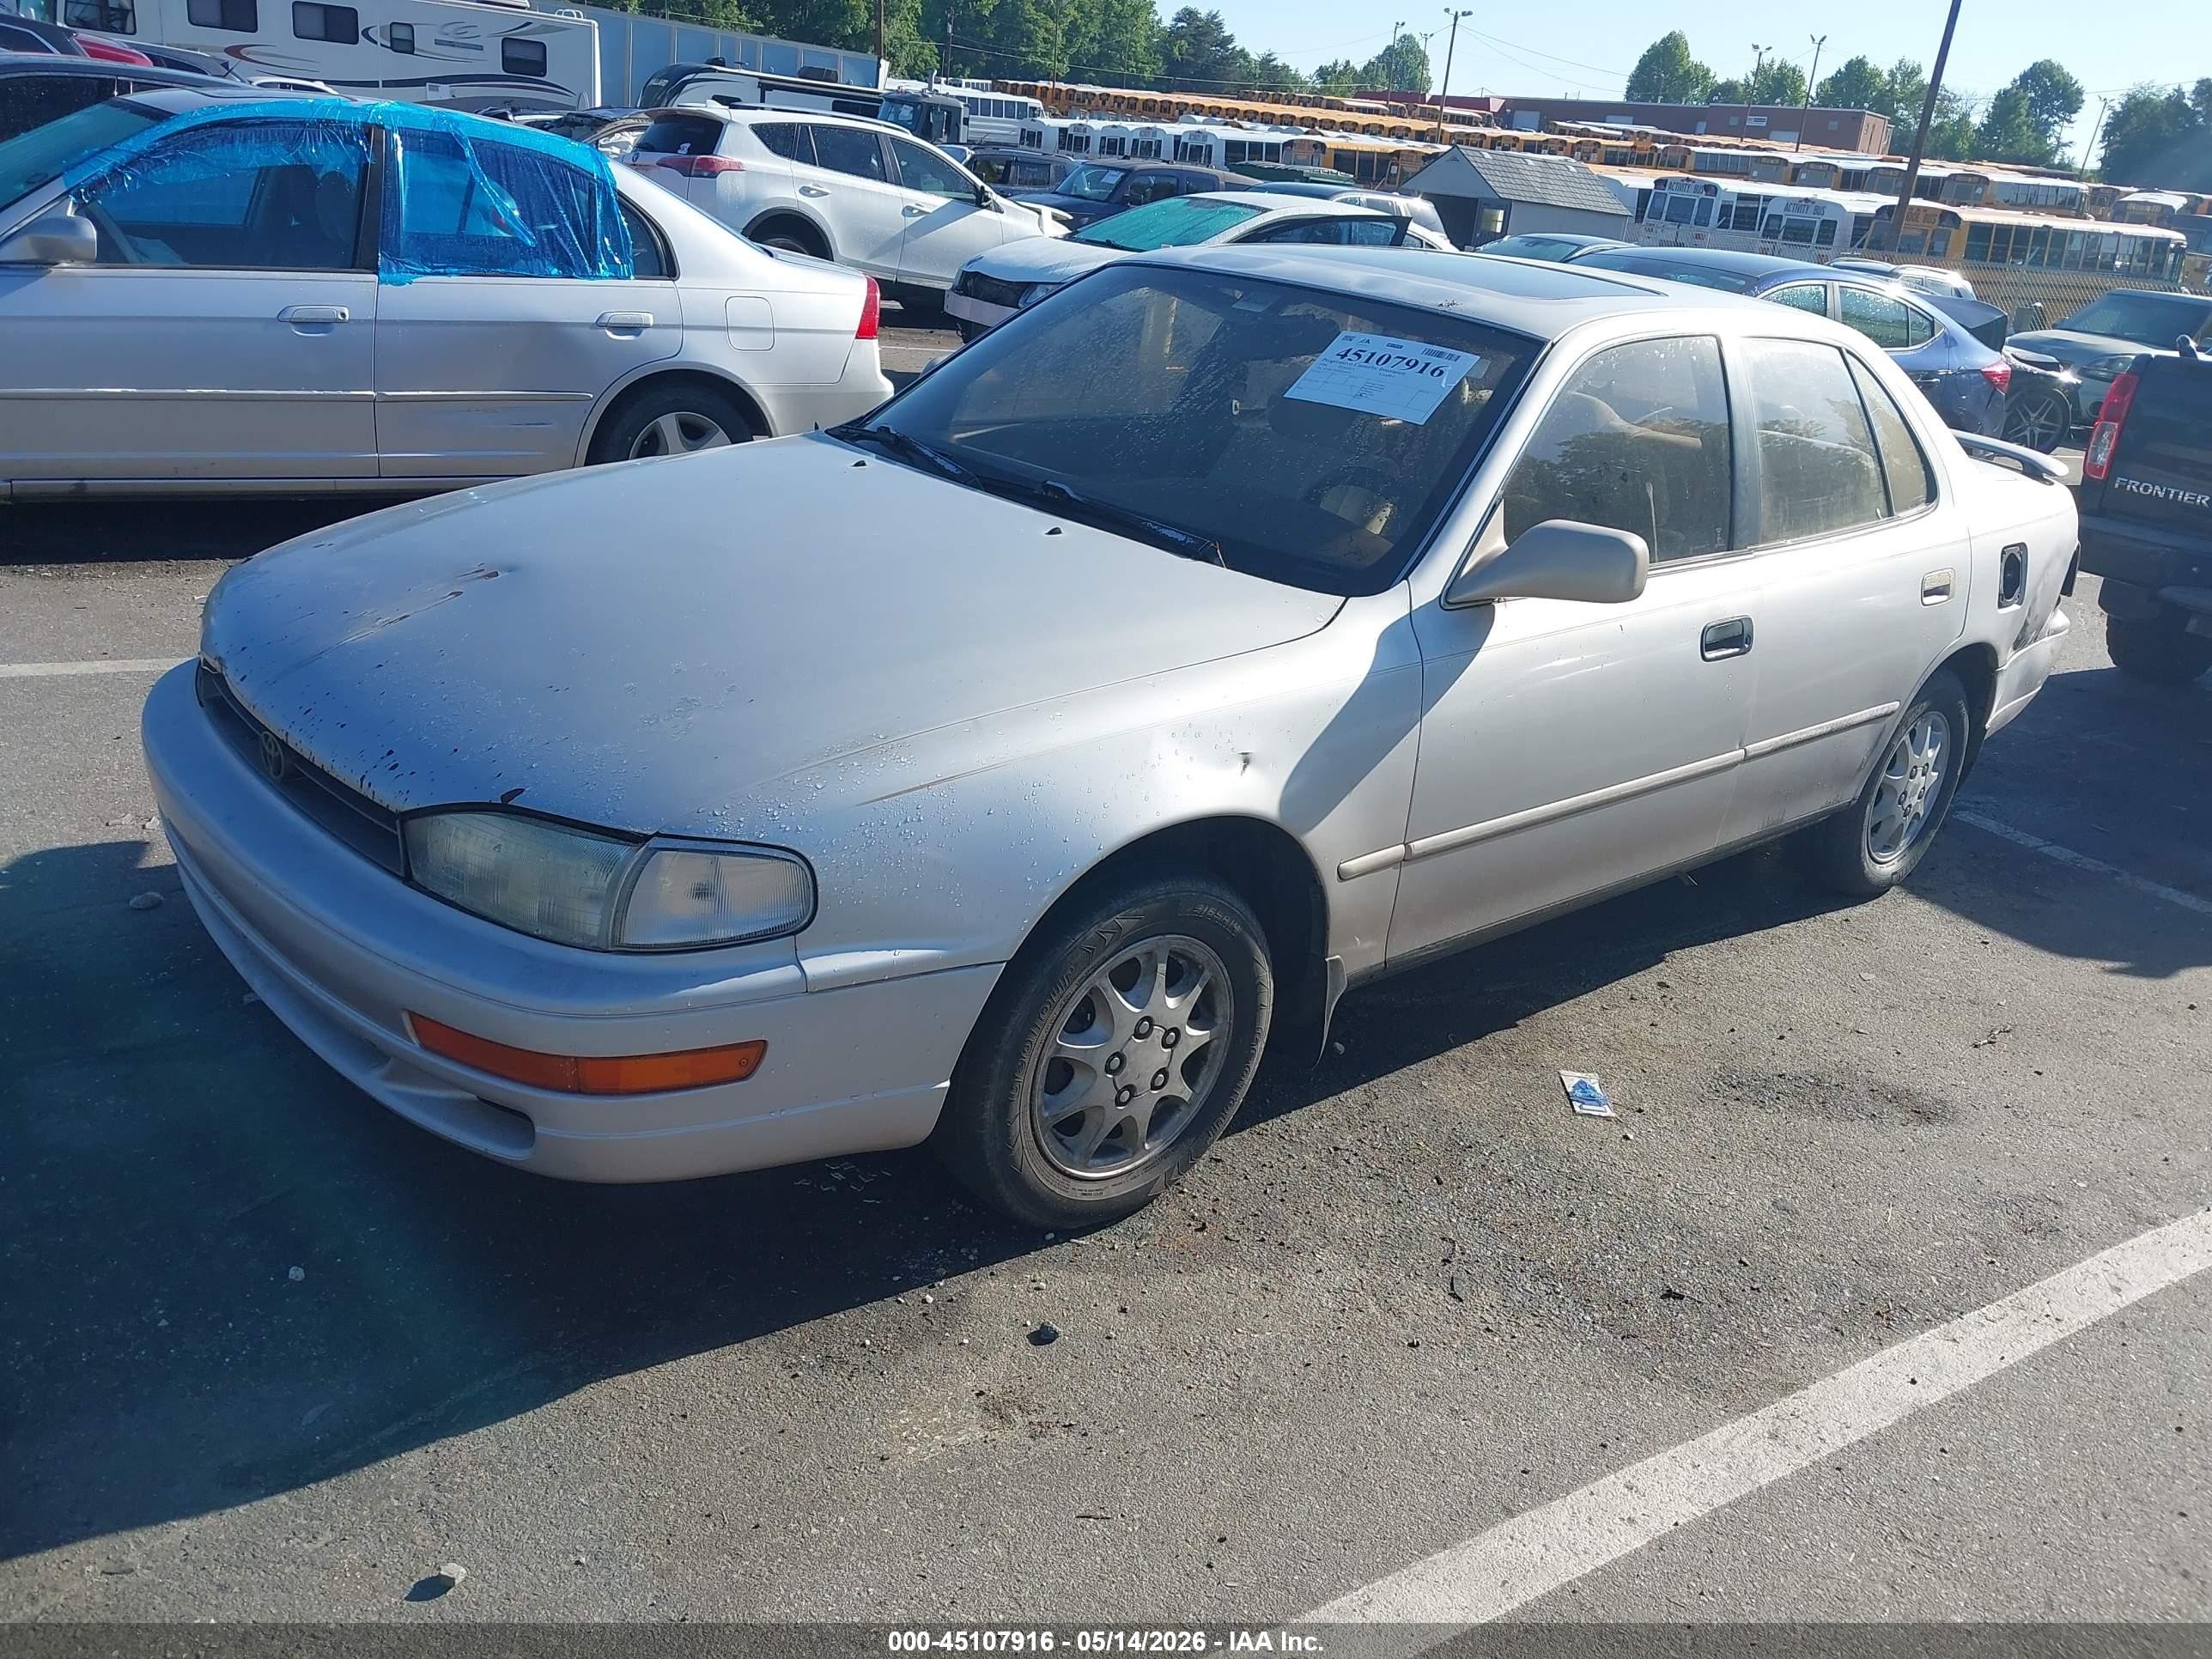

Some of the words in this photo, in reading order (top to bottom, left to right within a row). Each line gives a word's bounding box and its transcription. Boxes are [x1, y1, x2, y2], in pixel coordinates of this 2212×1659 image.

[1784, 201, 1810, 215] ACTIVITY
[1813, 204, 1826, 216] BUS
[1335, 347, 1450, 379] 45107916
[2114, 477, 2211, 508] FRONTIER
